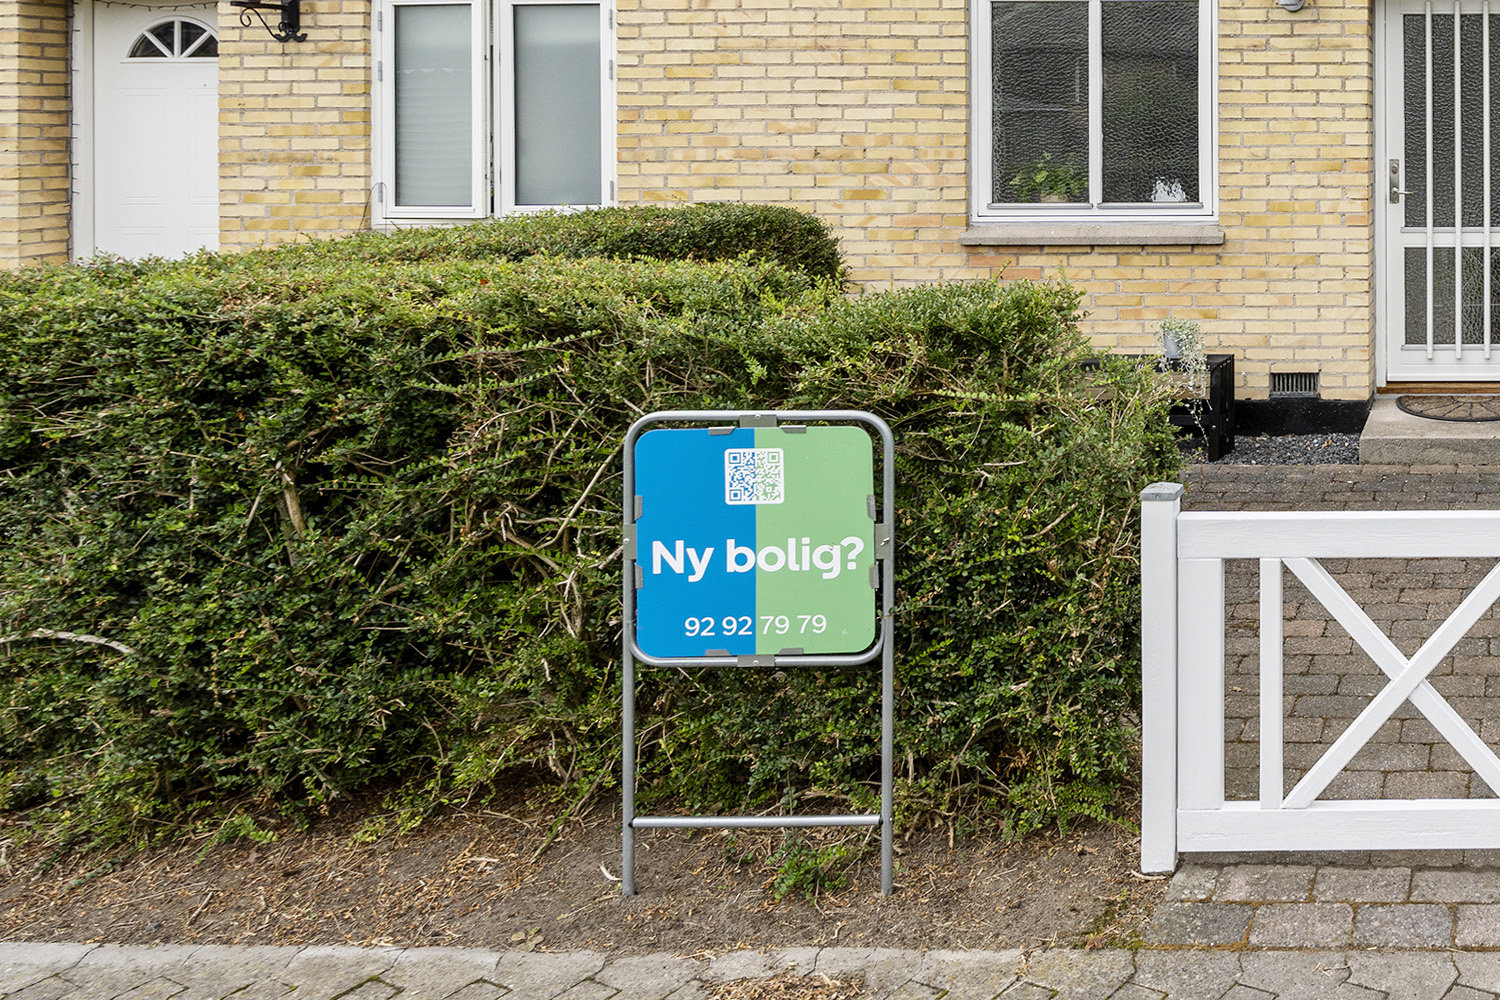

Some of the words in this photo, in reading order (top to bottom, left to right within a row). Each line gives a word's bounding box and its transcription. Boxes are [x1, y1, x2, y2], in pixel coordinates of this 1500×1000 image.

[652, 539, 714, 583] Ny
[726, 536, 864, 580] bolig?
[684, 616, 715, 637] 92
[722, 615, 753, 636] 92
[760, 614, 790, 635] 79
[796, 614, 827, 634] 79
